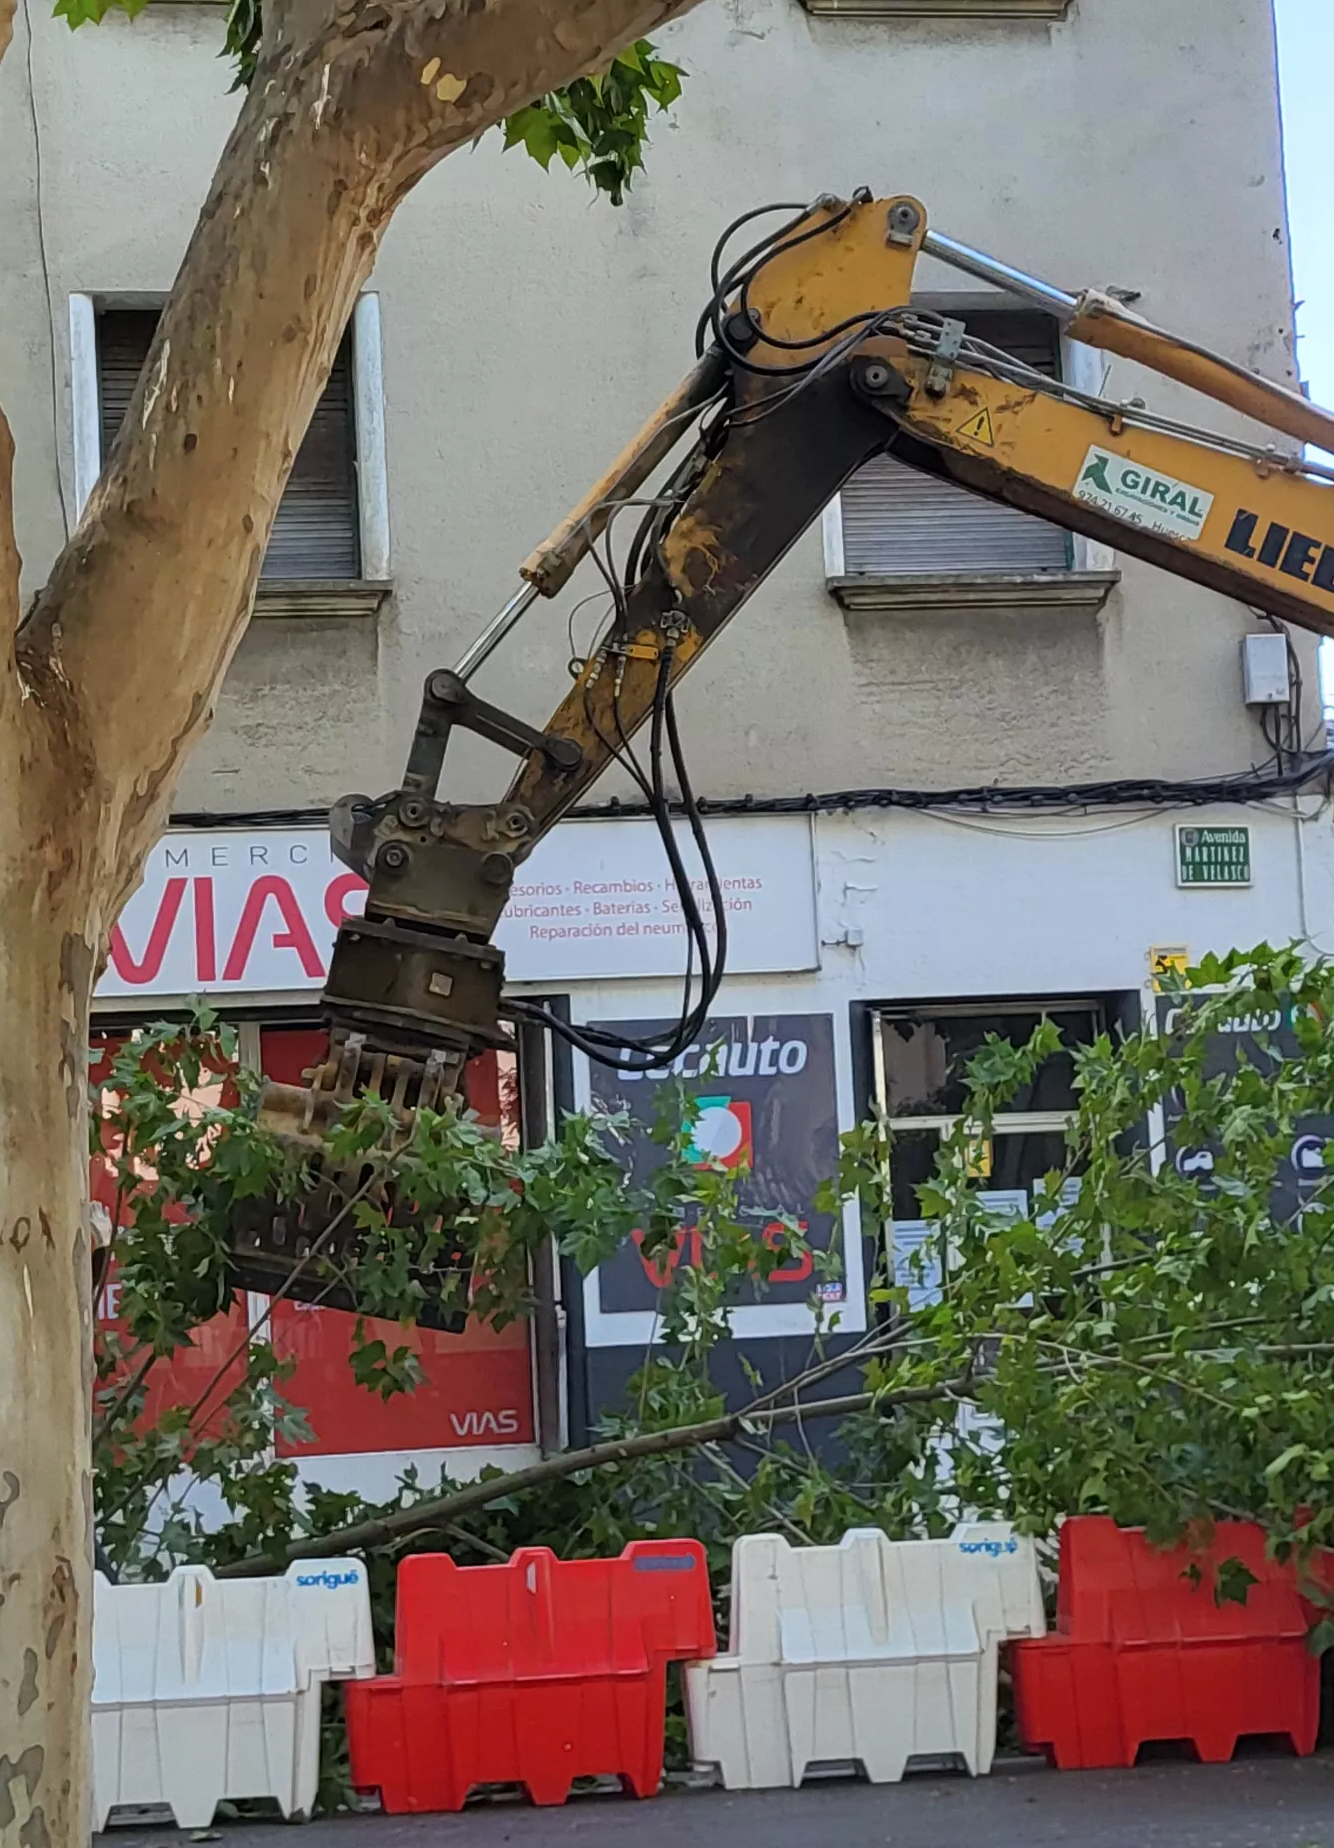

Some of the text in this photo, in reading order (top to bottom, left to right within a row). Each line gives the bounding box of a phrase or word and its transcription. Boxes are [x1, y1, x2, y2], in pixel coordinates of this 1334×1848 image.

[1120, 469, 1203, 519] GIRAL
[1201, 829, 1246, 844] Avenida
[1182, 864, 1250, 881] DE VELASCO
[509, 882, 562, 897] esorios
[573, 879, 653, 894] Recambios
[500, 903, 581, 918] ubricantes
[530, 924, 611, 942] Reparación
[616, 922, 639, 936] del
[630, 1221, 814, 1288] VIS
[450, 1409, 520, 1437] VIAS
